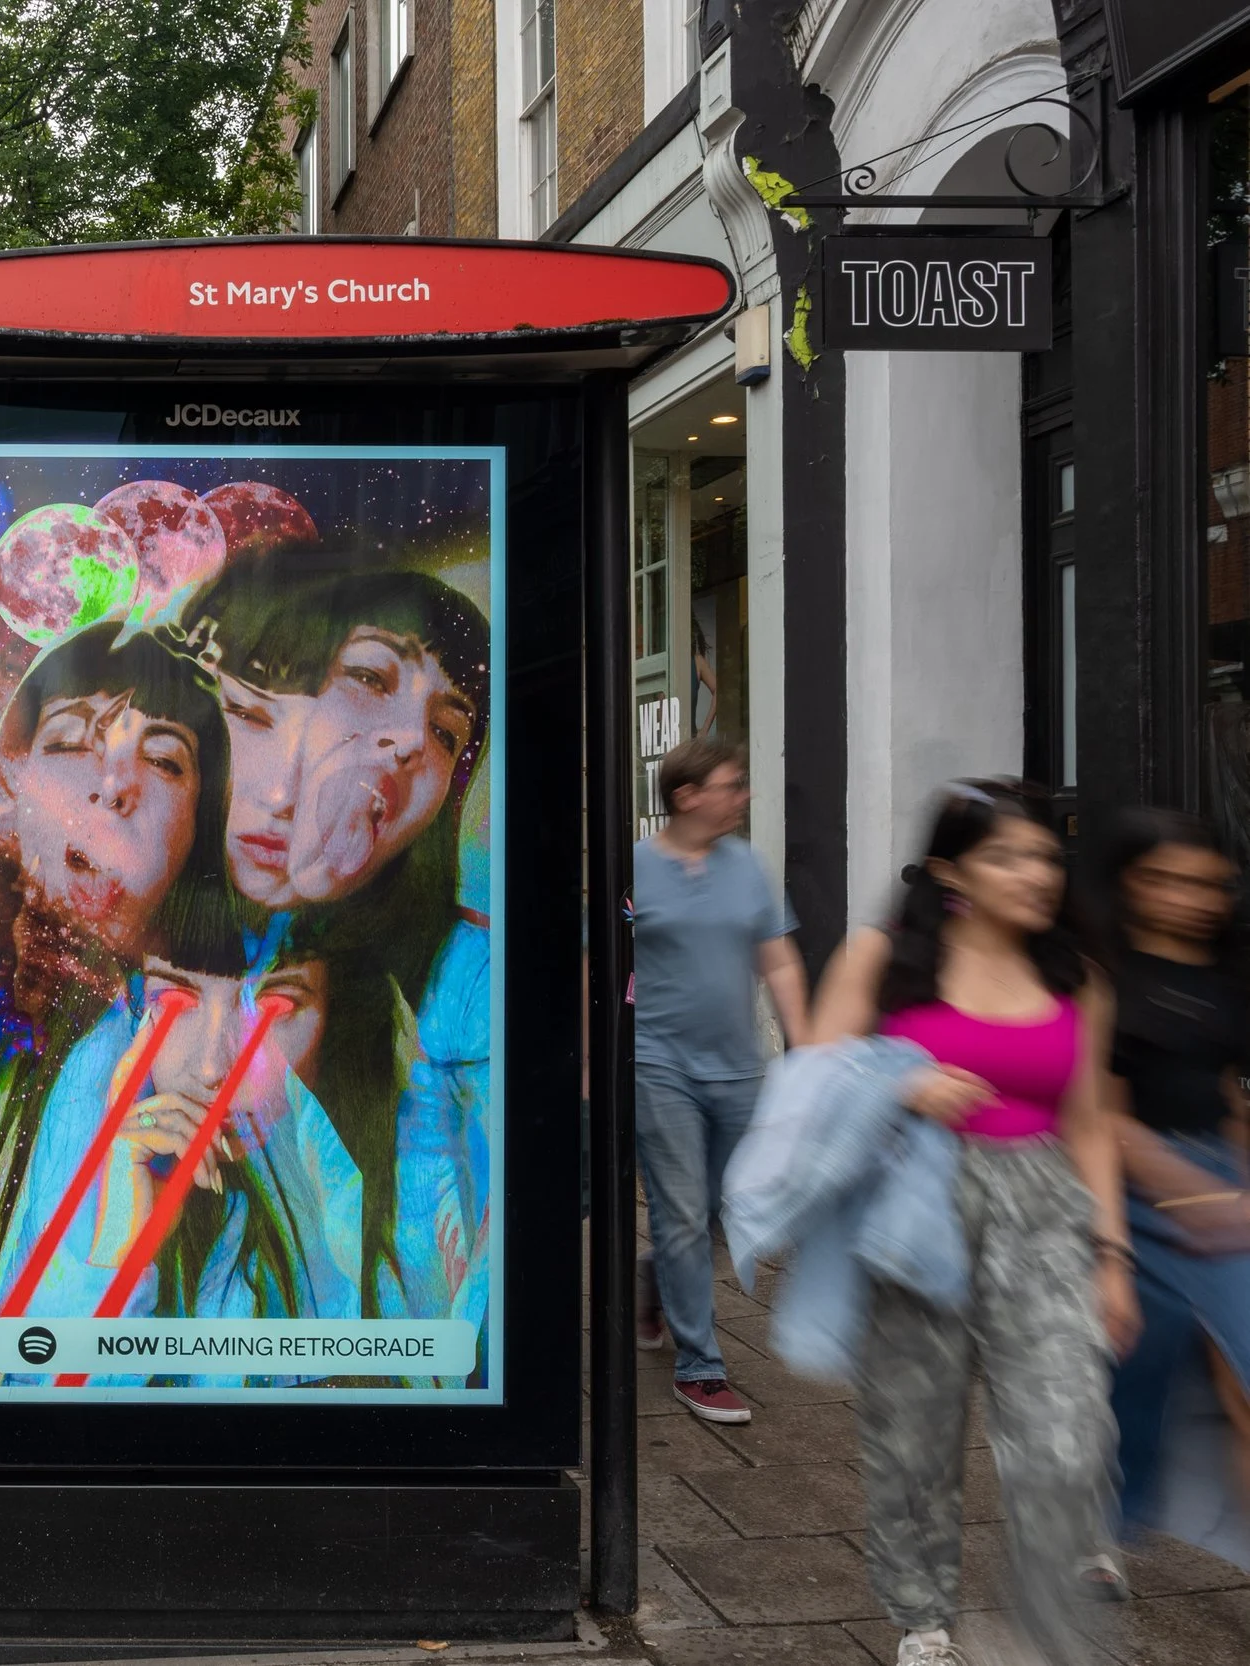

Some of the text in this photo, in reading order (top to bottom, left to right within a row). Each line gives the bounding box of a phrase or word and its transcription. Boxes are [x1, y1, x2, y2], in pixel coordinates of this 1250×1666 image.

[189, 277, 431, 310] St Mary's Church
[841, 260, 1035, 328] TOAST
[165, 402, 301, 428] JCDecaux
[639, 696, 680, 757] WEAR
[97, 1336, 435, 1359] NOW BLAMING RETROGRADE
